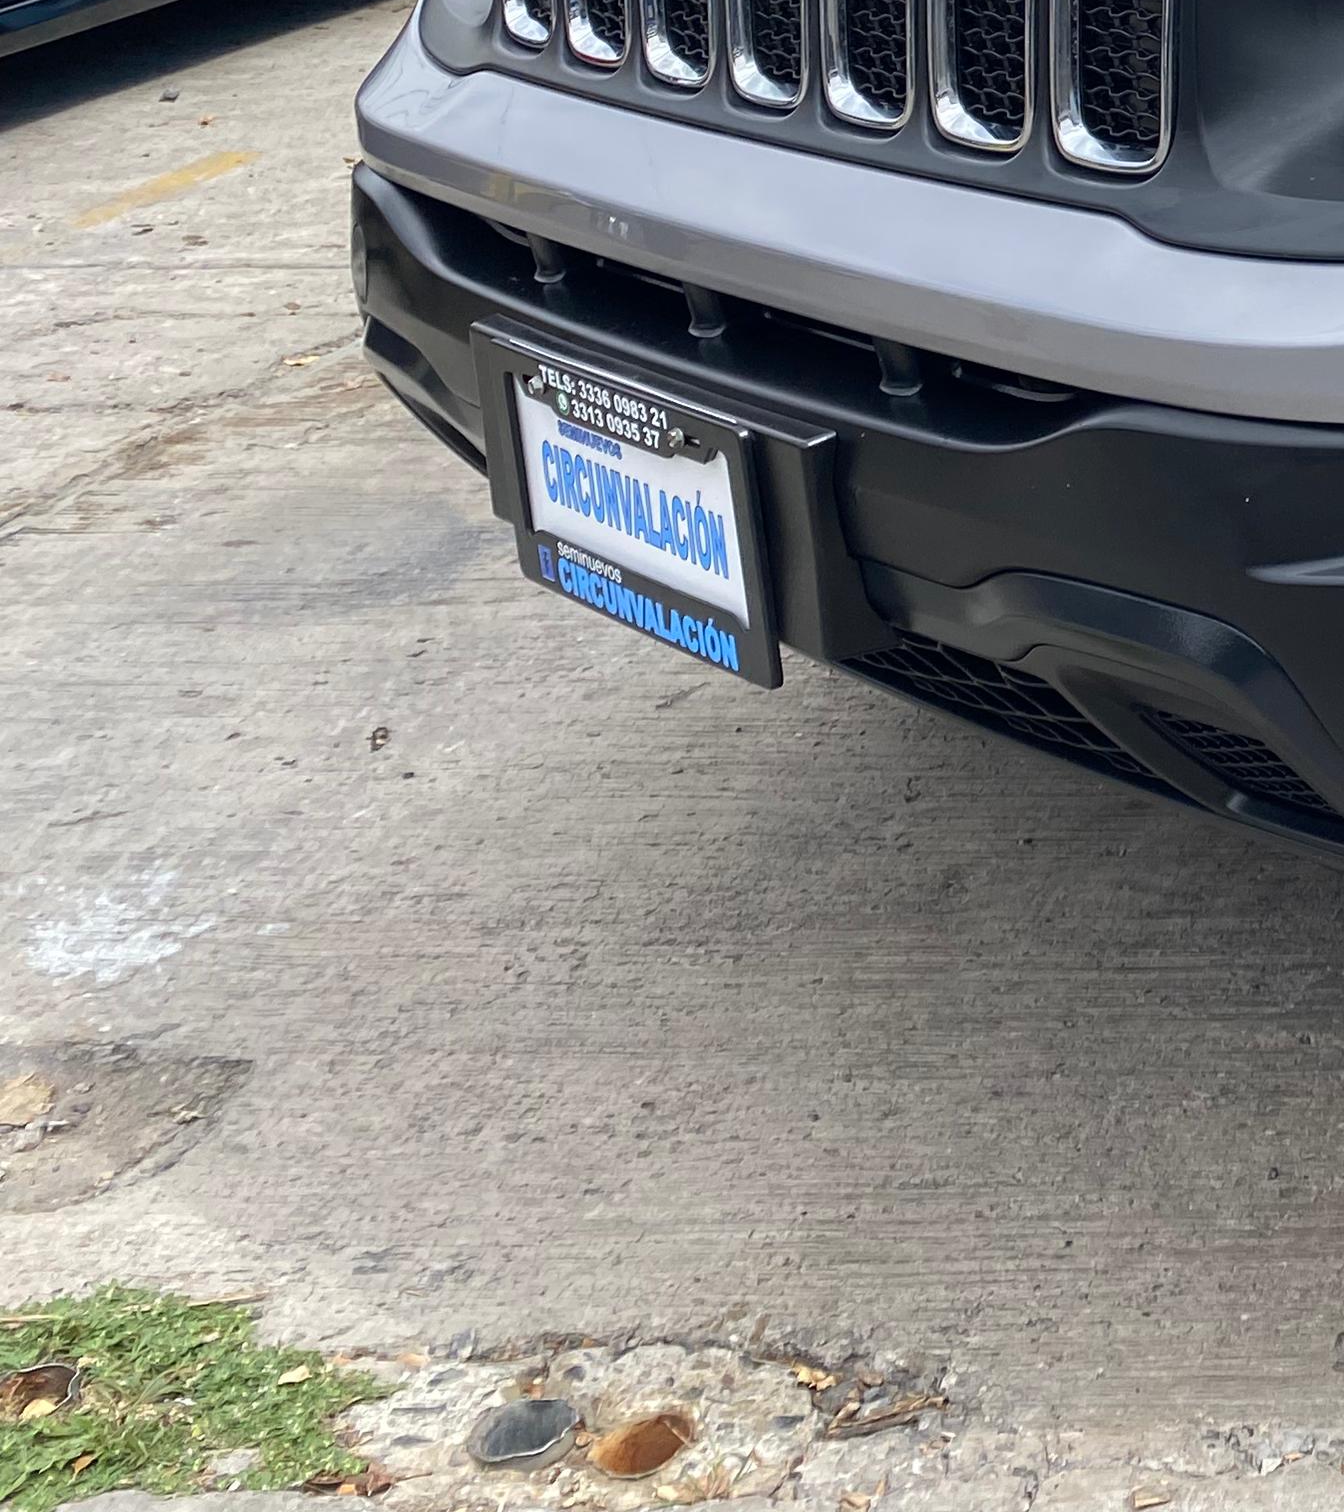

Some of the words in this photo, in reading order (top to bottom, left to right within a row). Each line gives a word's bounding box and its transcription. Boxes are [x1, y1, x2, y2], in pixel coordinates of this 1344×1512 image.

[538, 364, 576, 395] TELS:
[577, 380, 611, 409] 3336
[613, 394, 648, 423] 0983
[649, 407, 667, 430] 21
[571, 399, 604, 428] 3313
[606, 413, 640, 442] 0935
[642, 426, 660, 449] 37
[541, 439, 730, 581] CIRCUNVALACIÓN
[556, 541, 623, 584] seminuevos
[557, 556, 740, 672] CIRCUNVALACIÓN
